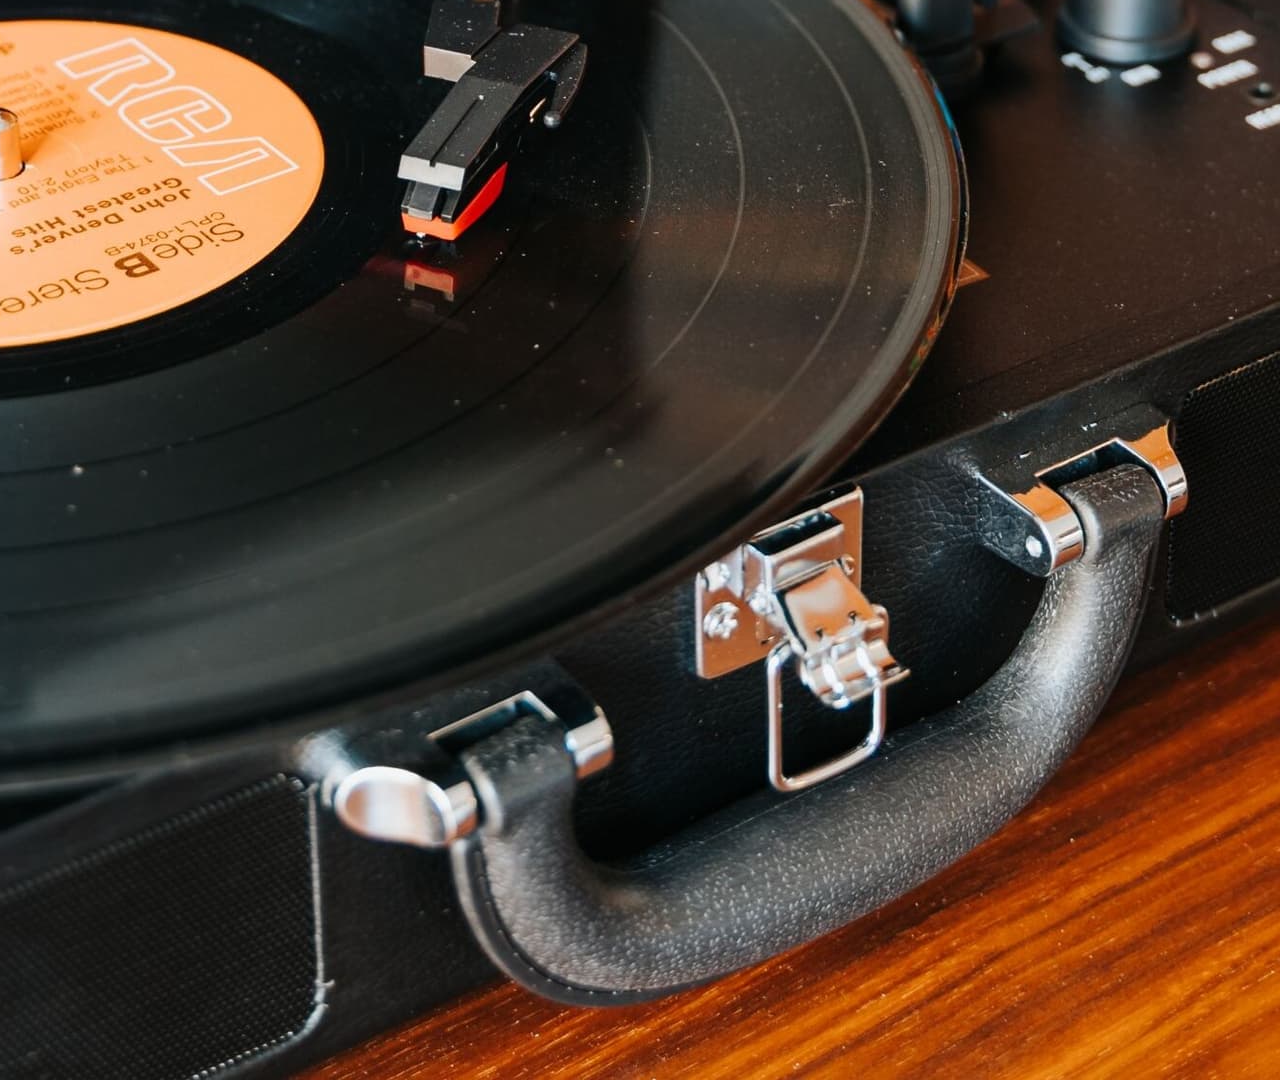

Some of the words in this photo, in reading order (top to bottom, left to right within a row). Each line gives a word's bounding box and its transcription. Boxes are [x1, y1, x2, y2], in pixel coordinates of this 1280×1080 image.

[16, 115, 87, 142] Sunshin
[58, 39, 295, 194] RCA
[62, 153, 129, 179] Taylor)
[103, 161, 139, 177] The
[15, 177, 57, 195] 2:10
[45, 173, 100, 196] Eagle
[7, 193, 42, 208] and
[73, 178, 182, 218] Greatest
[131, 189, 190, 213] John
[10, 213, 123, 254] Denver's
[12, 217, 65, 237] Hits
[105, 212, 224, 256] CPL1-0374-B
